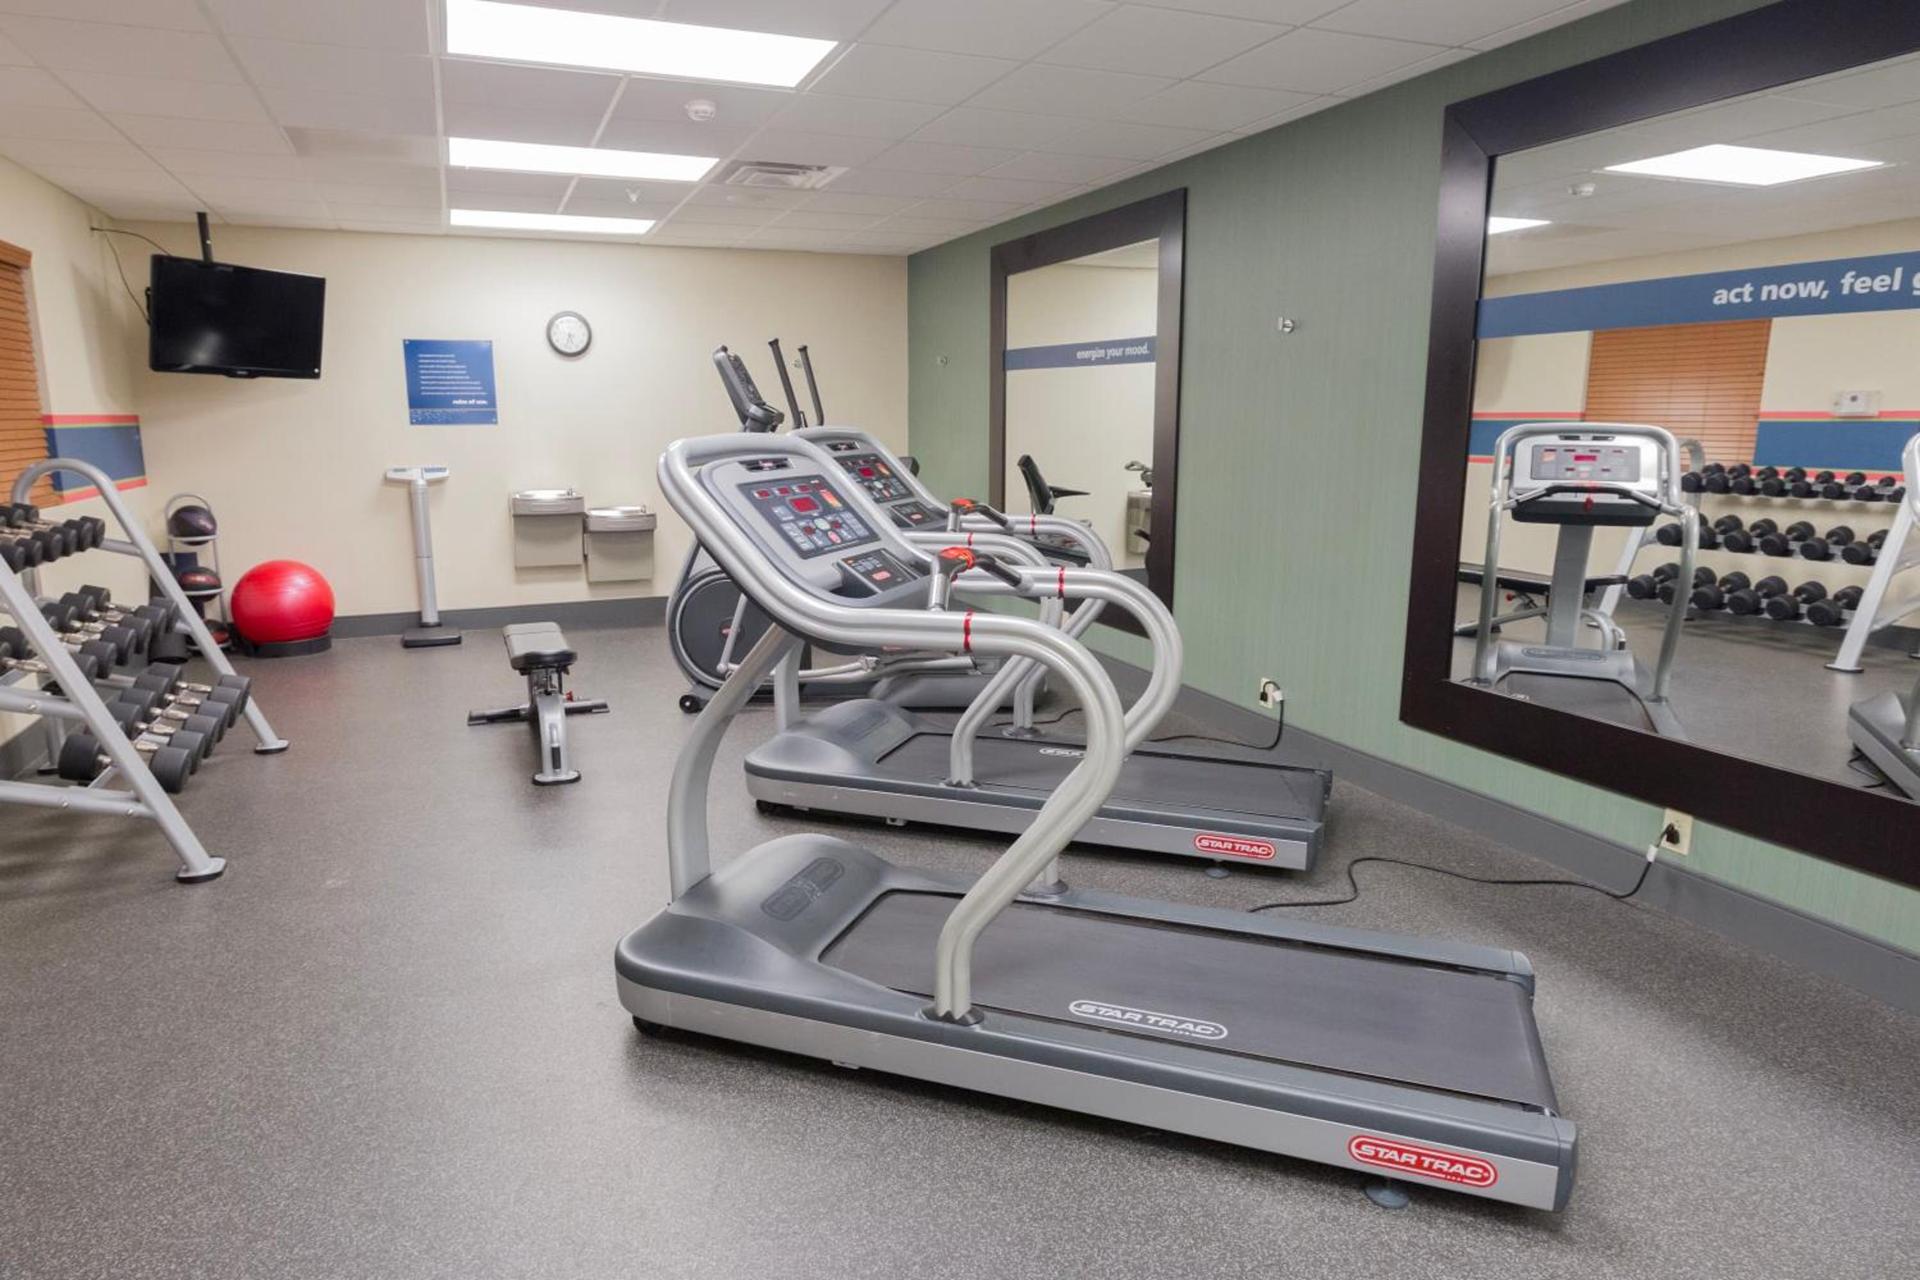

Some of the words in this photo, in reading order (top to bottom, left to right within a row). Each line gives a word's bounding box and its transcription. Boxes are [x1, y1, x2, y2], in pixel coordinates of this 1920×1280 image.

[1713, 282, 1753, 306] act
[1760, 279, 1830, 299] now,
[1840, 267, 1903, 295] feel
[1106, 347, 1125, 360] your
[1125, 343, 1151, 356] mood.
[1200, 839, 1233, 850] STAR
[1234, 843, 1269, 855] TRAC
[1079, 1004, 1142, 1022] STAR
[1146, 1015, 1217, 1034] TRAC
[1360, 1144, 1418, 1165] STAR
[1420, 1156, 1486, 1179] TRAC
